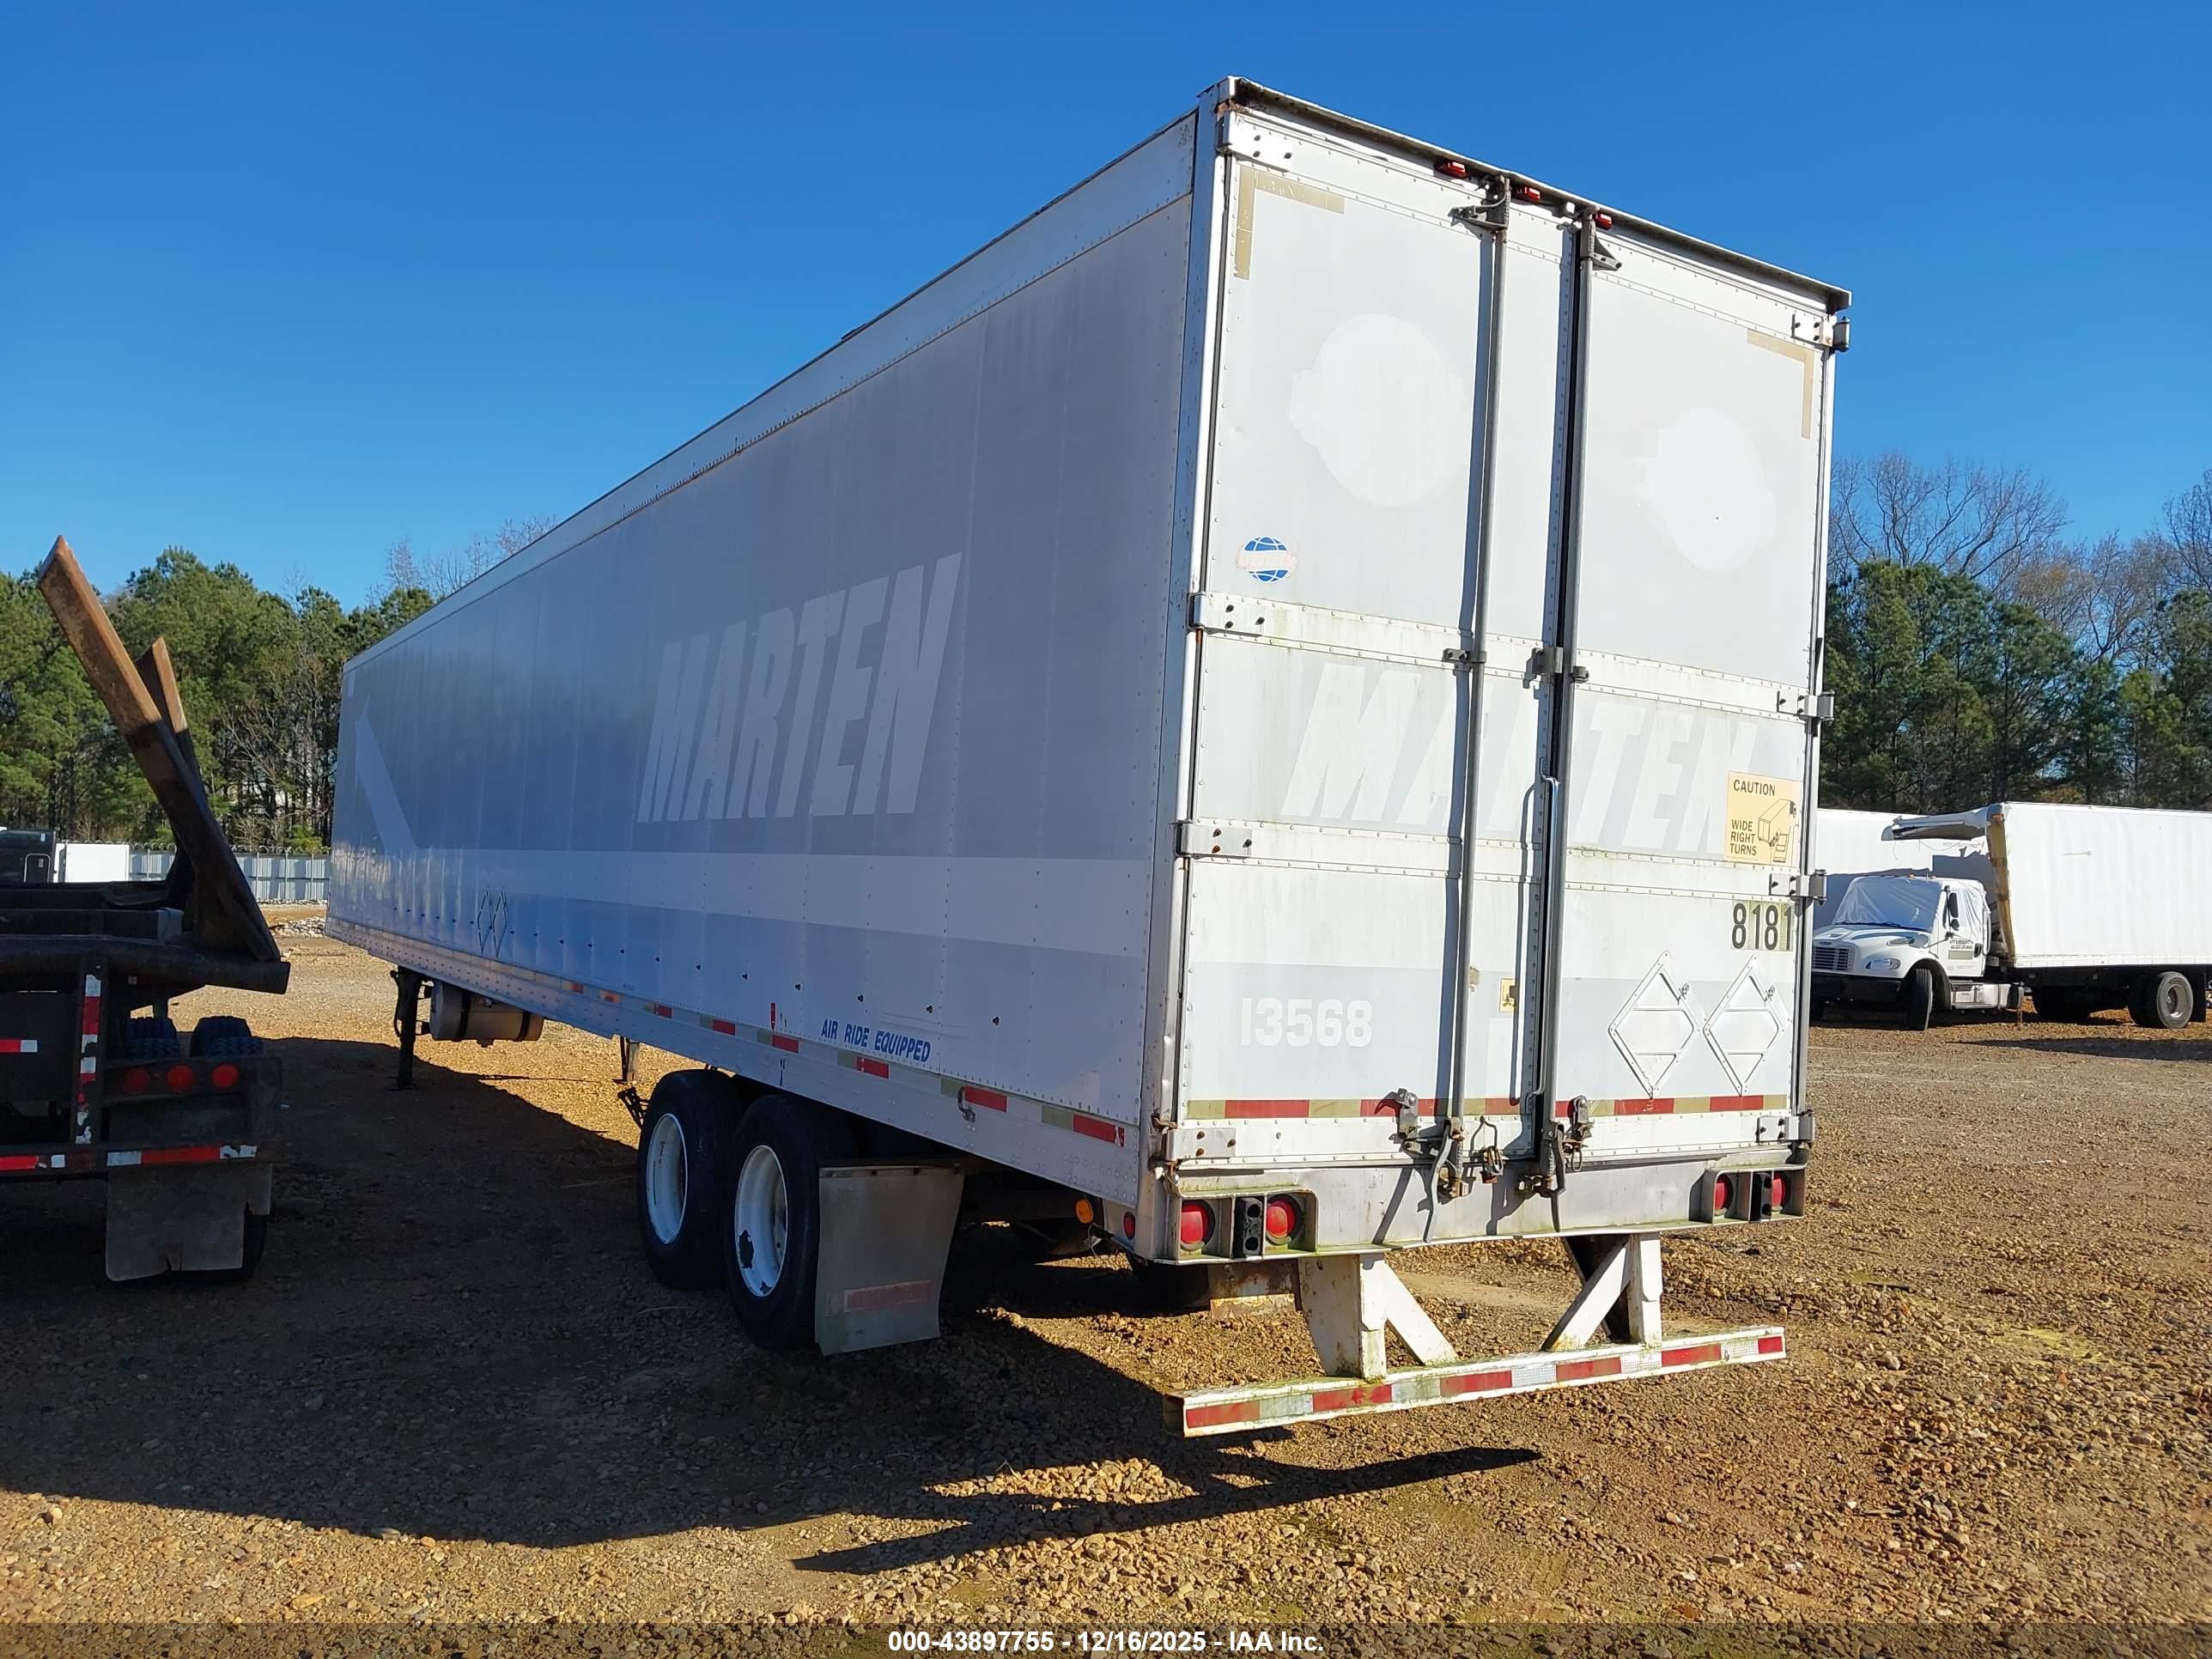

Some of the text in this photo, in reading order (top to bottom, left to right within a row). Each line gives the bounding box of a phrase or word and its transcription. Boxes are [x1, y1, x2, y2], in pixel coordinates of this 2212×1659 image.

[637, 552, 962, 823] MARTEN
[1733, 779, 1776, 796] CAUTION
[1730, 831, 1755, 843] RIGHT
[1731, 819, 1753, 831] WIDE
[1729, 843, 1757, 856] TURNS
[1732, 902, 1792, 951] 8181
[1242, 998, 1372, 1047] 13568
[822, 1018, 930, 1062] AIR RIDE EQUIPPED
